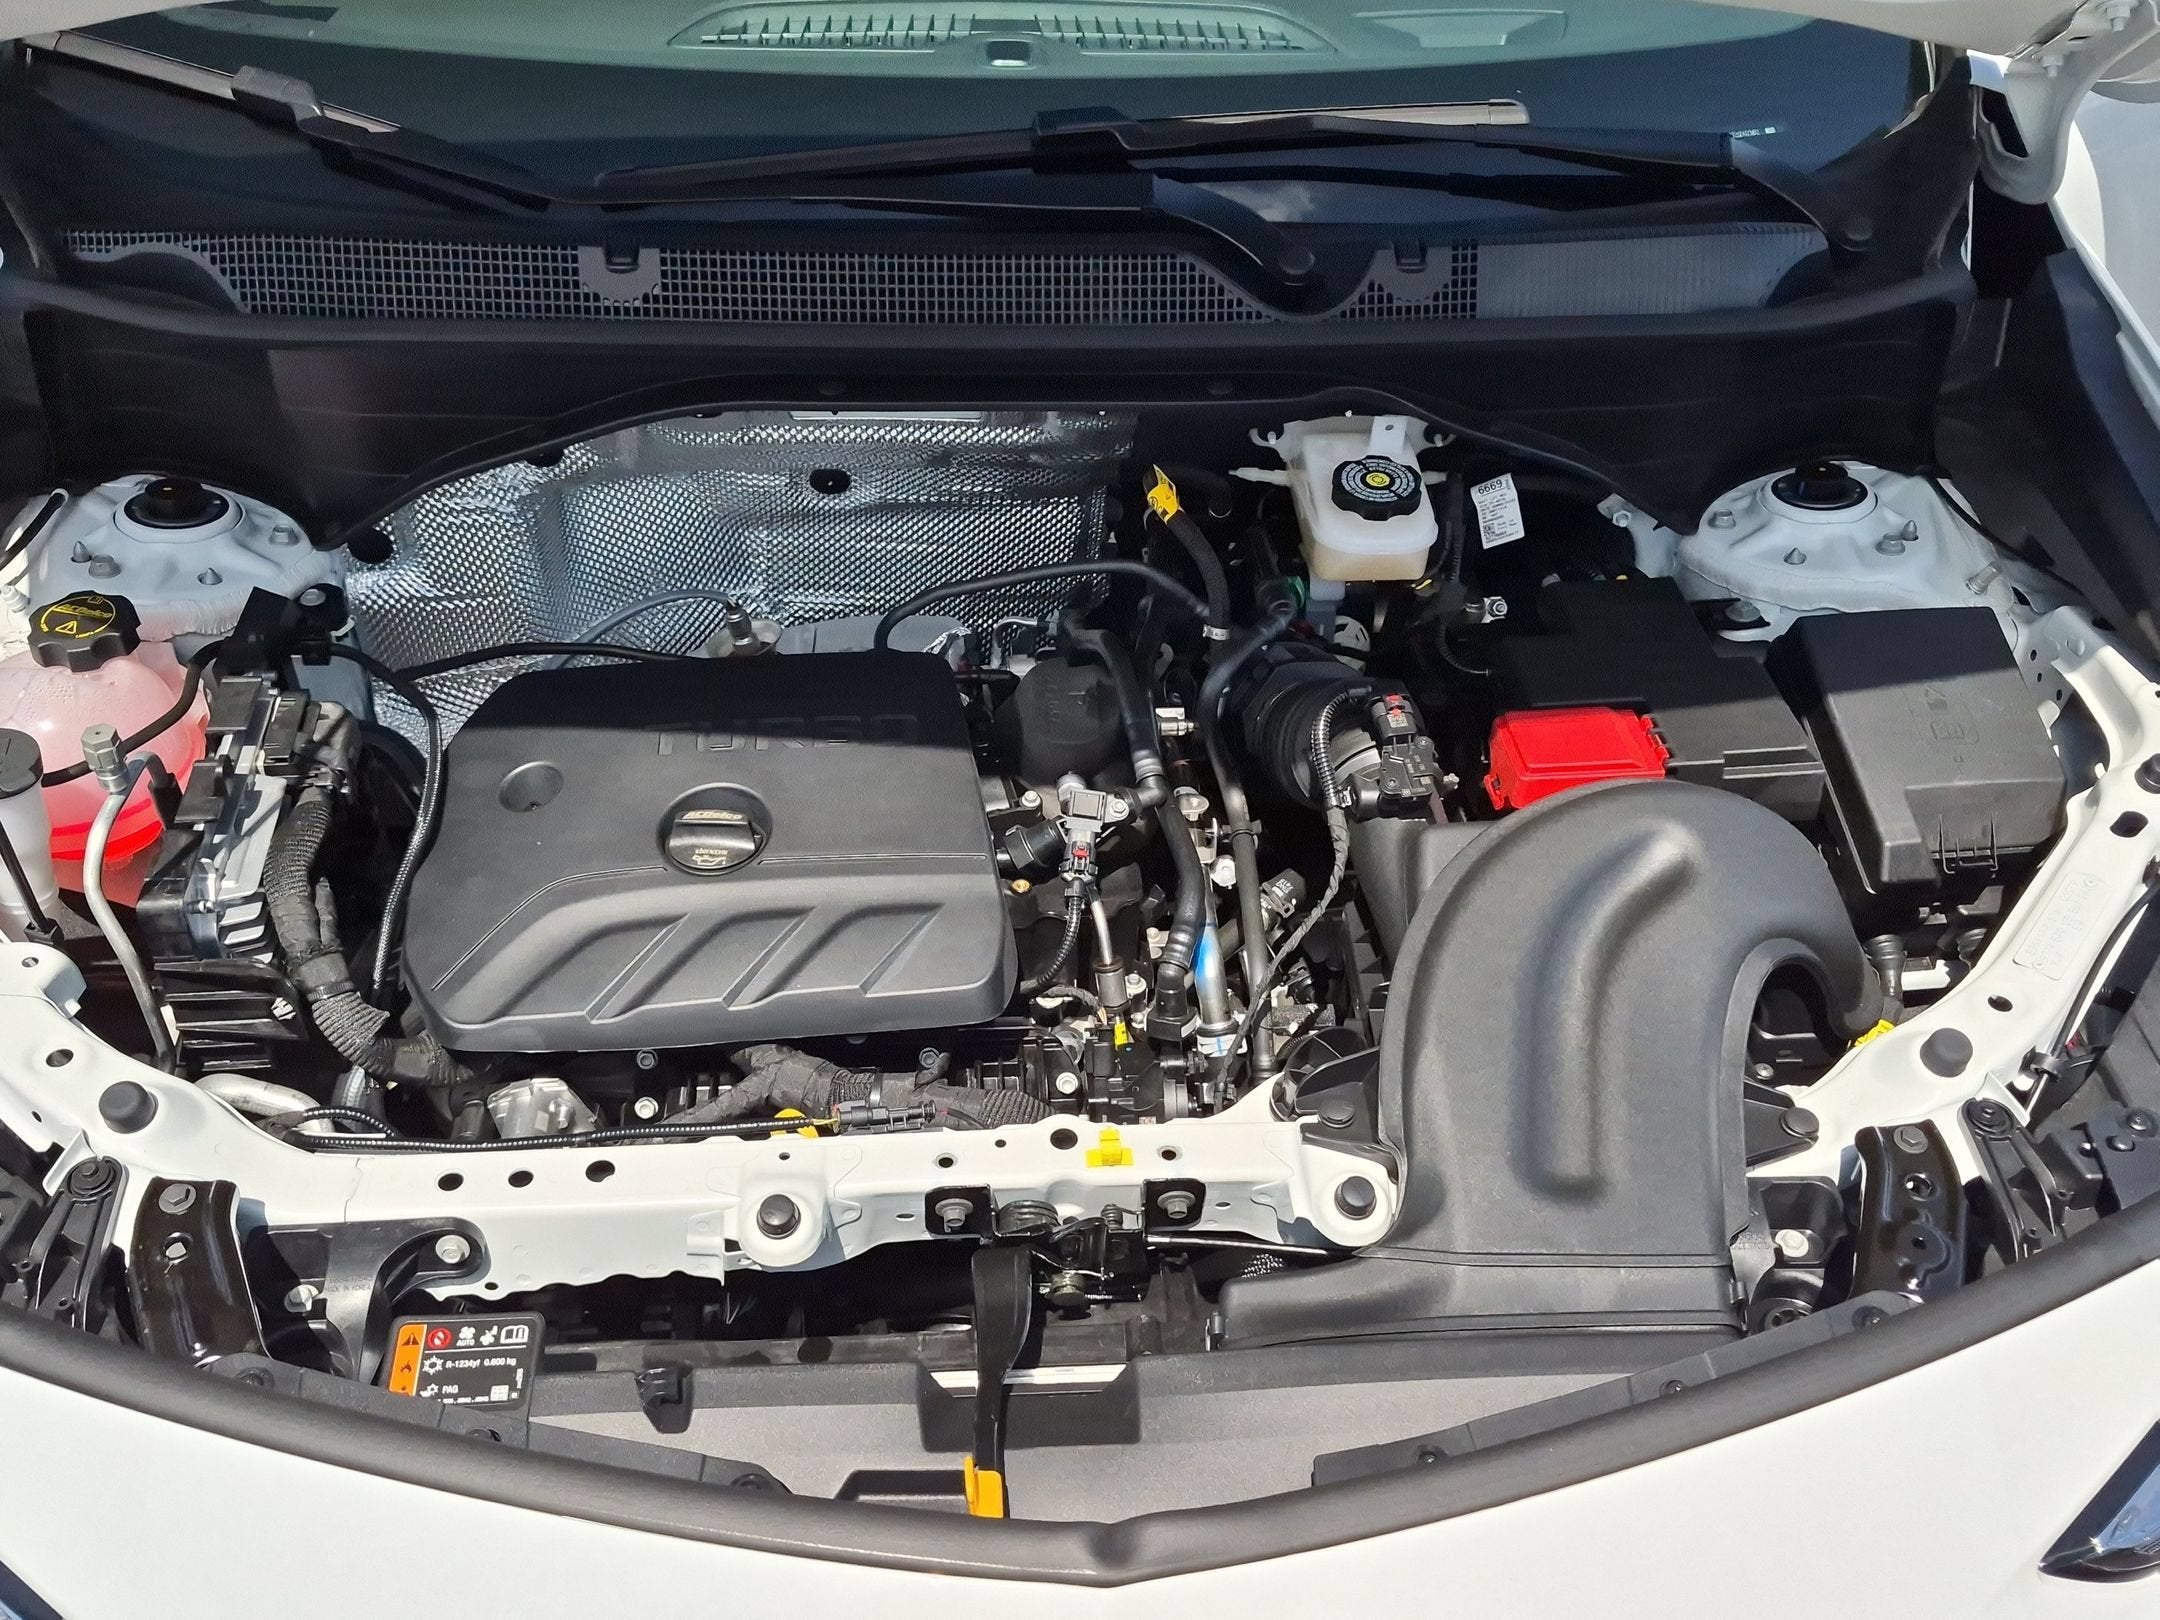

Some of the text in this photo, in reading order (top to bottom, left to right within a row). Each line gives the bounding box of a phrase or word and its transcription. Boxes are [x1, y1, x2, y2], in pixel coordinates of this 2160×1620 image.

[1478, 479, 1503, 495] 6669
[58, 603, 113, 619] ACDelco
[644, 714, 919, 756] TURBO
[686, 811, 744, 821] ACDelco
[695, 847, 729, 855] dexos
[456, 1338, 475, 1346] AUTO
[445, 1358, 481, 1369] R-1234yf
[506, 1356, 517, 1367] kg
[442, 1385, 459, 1394] PAG
